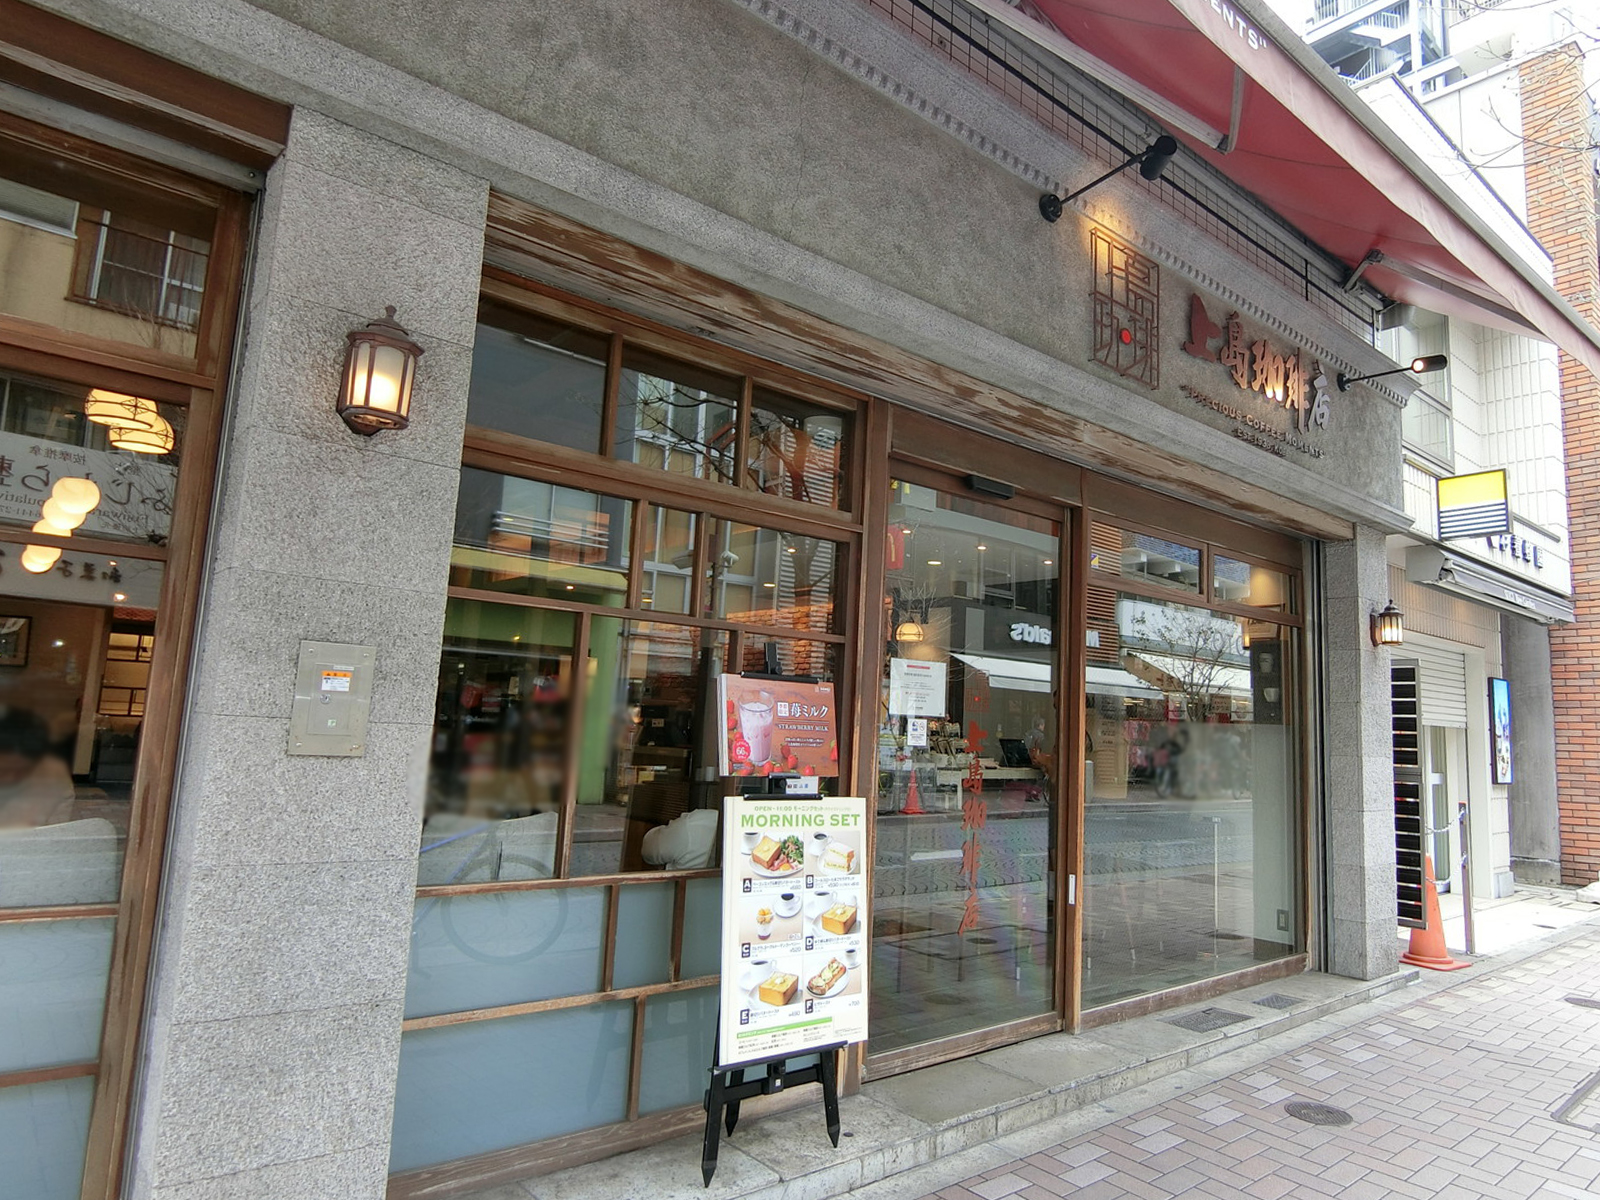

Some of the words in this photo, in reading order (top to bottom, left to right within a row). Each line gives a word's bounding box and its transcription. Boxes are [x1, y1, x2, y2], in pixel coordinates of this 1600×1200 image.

[1182, 293, 1330, 435] 上島珈琲店
[1246, 414, 1282, 439] COFFEE
[790, 702, 829, 718] 苺ミルク
[777, 723, 814, 731] STRAWBERRY
[741, 814, 825, 828] MORNING
[830, 814, 861, 828] SET
[957, 720, 989, 936] 上島珈琲店
